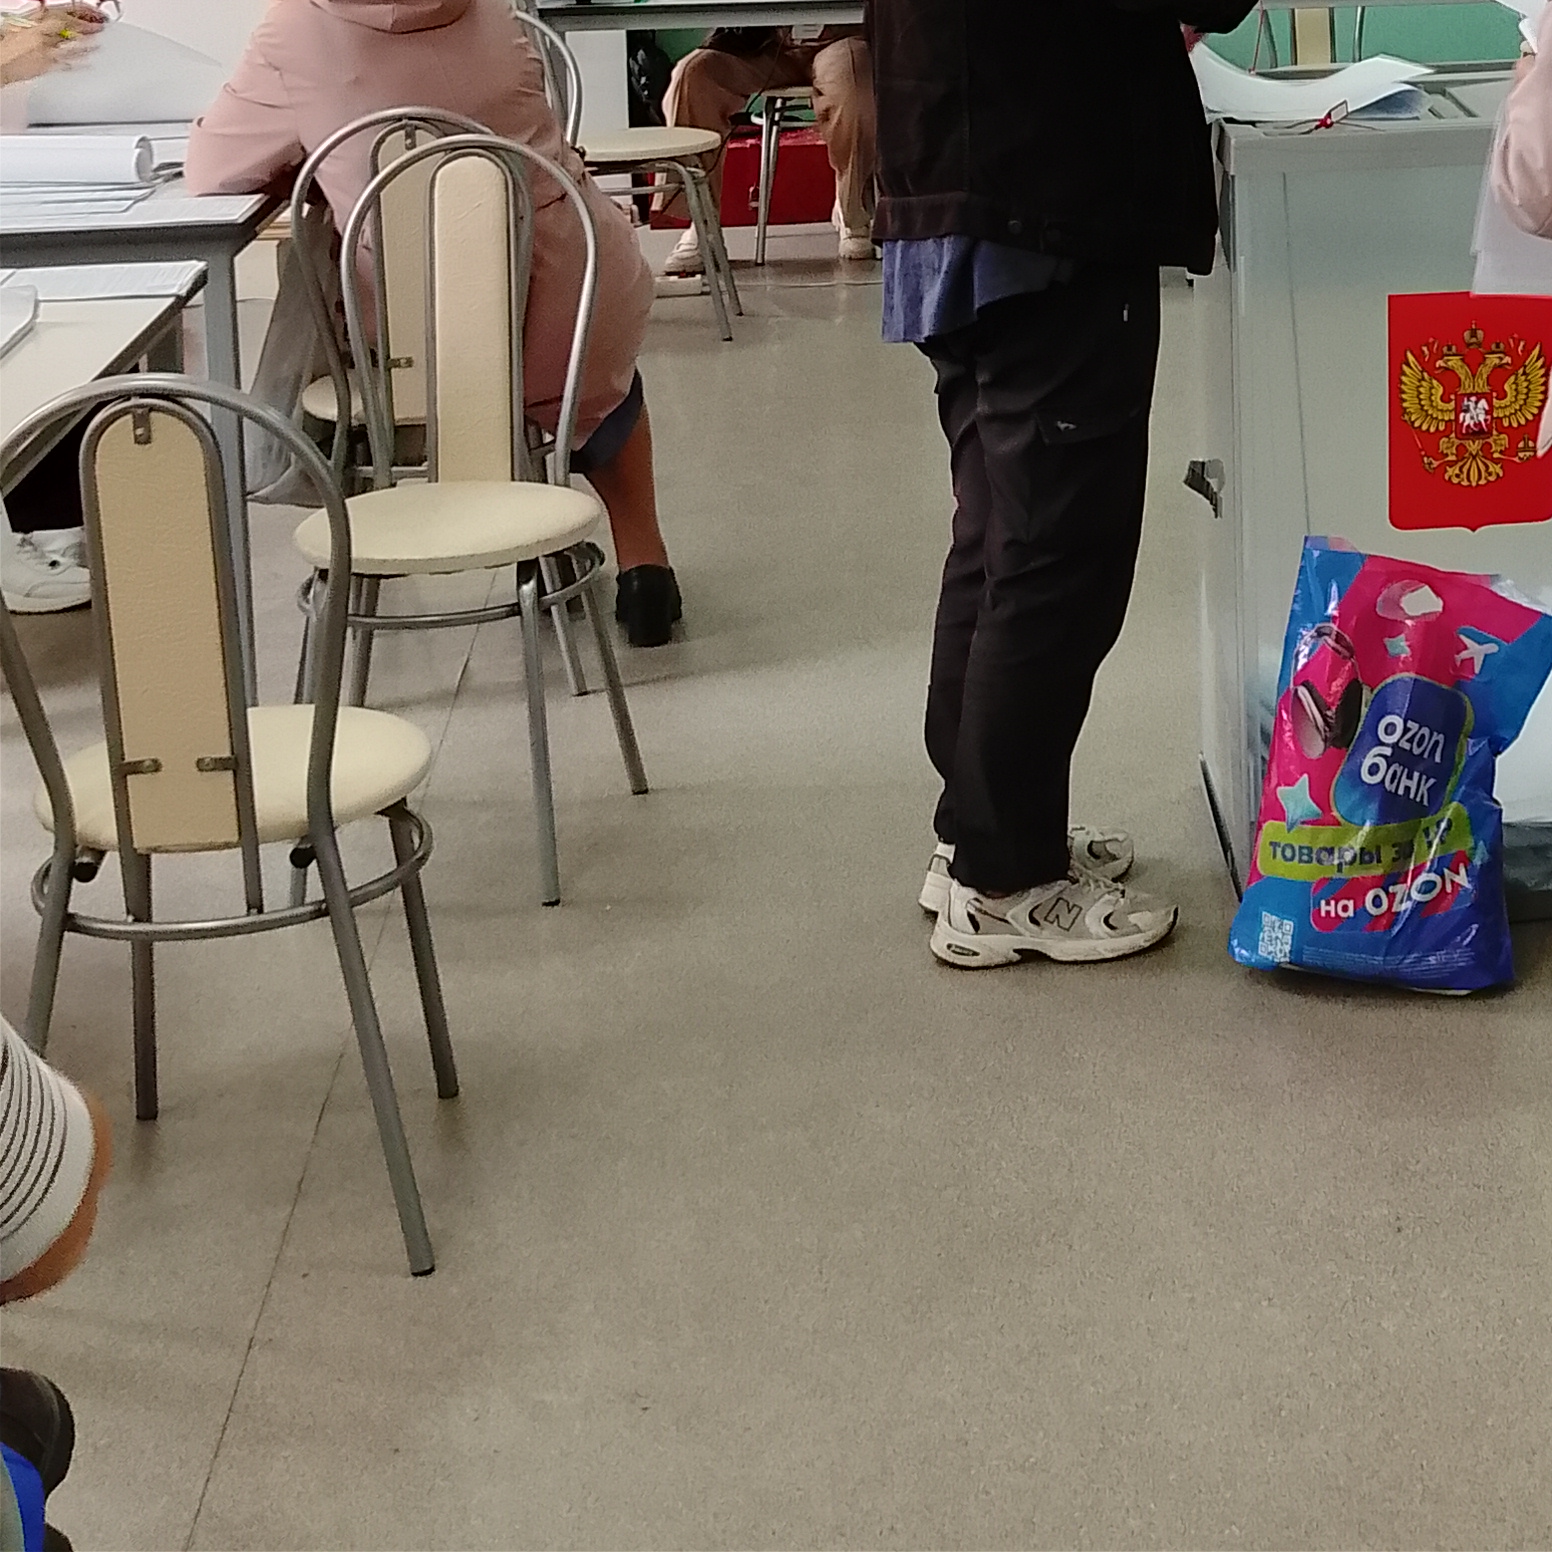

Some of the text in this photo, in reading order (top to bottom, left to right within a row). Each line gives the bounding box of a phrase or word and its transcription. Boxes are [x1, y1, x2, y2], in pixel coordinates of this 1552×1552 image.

[1361, 746, 1437, 807] банк
[1269, 841, 1382, 874] товары
[1320, 898, 1354, 918] на
